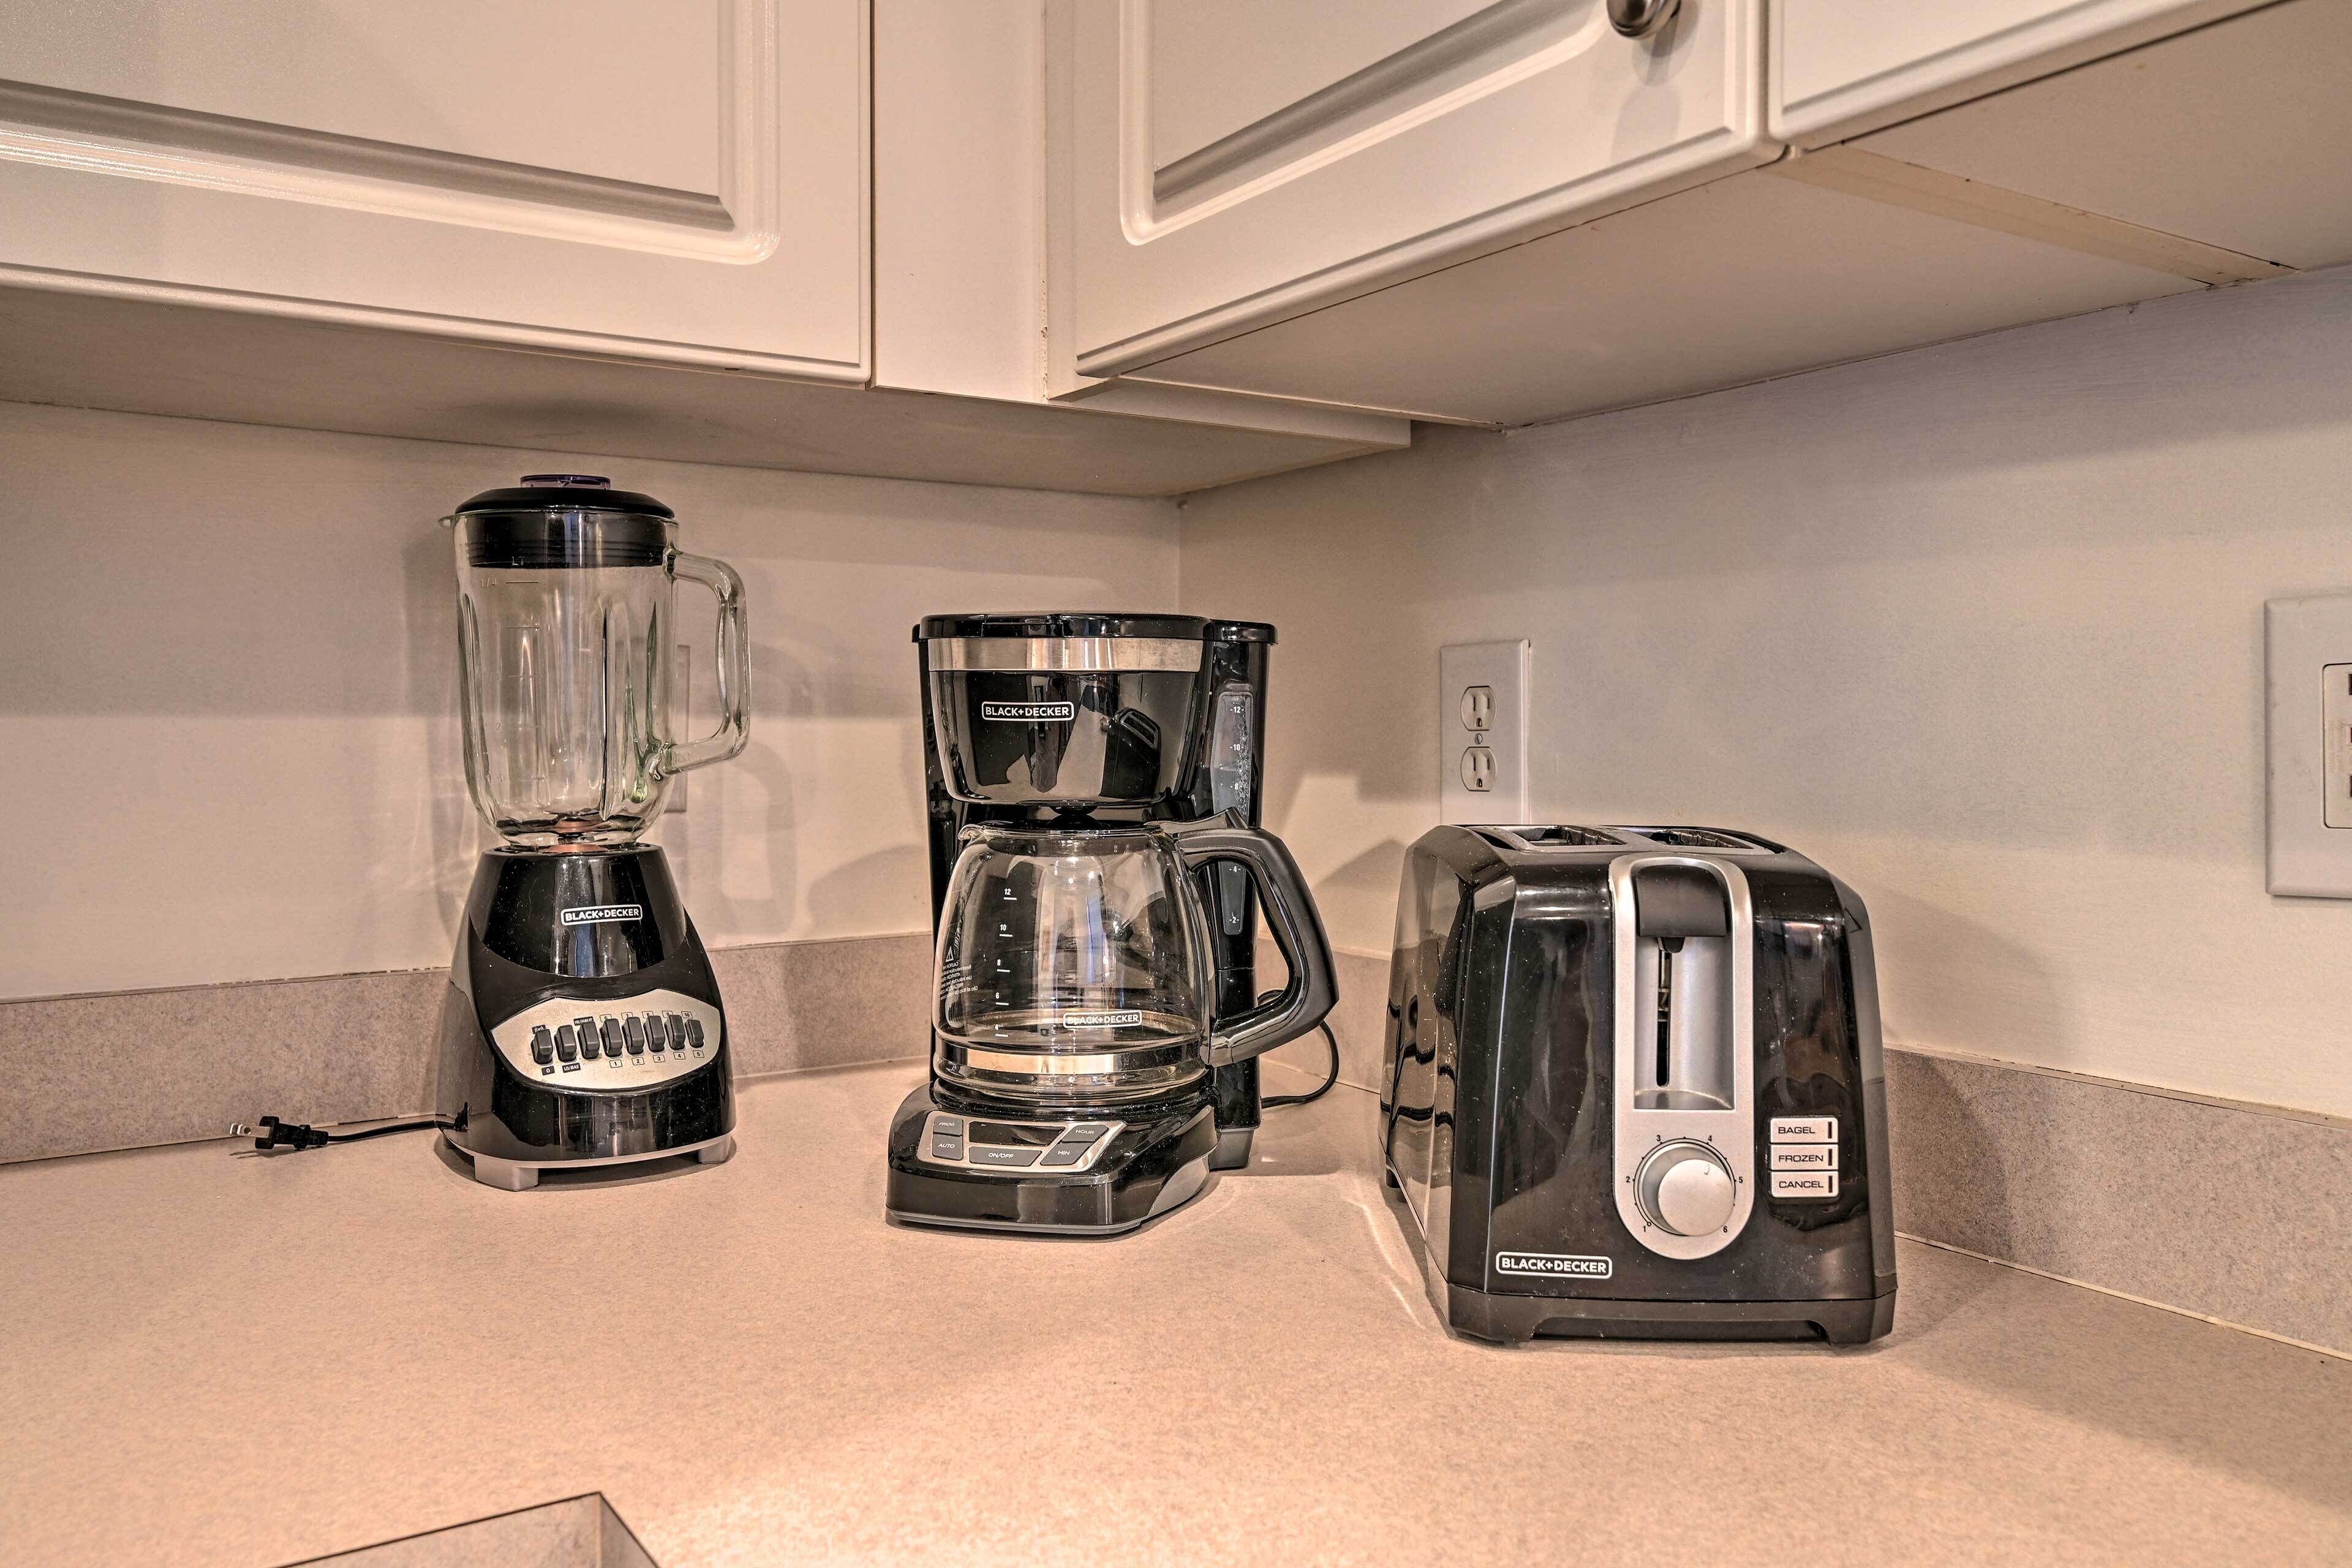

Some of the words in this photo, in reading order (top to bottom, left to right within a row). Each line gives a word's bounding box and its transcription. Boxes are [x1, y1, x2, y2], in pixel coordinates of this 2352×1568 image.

[985, 706, 1069, 717] BLACK+DECKER
[565, 908, 640, 922] BLACK+DECKER
[1067, 1014, 1139, 1025] BLACK+DECKER
[1779, 1180, 1825, 1189] CANCEL
[1501, 1257, 1607, 1273] BLACK+DECKER
